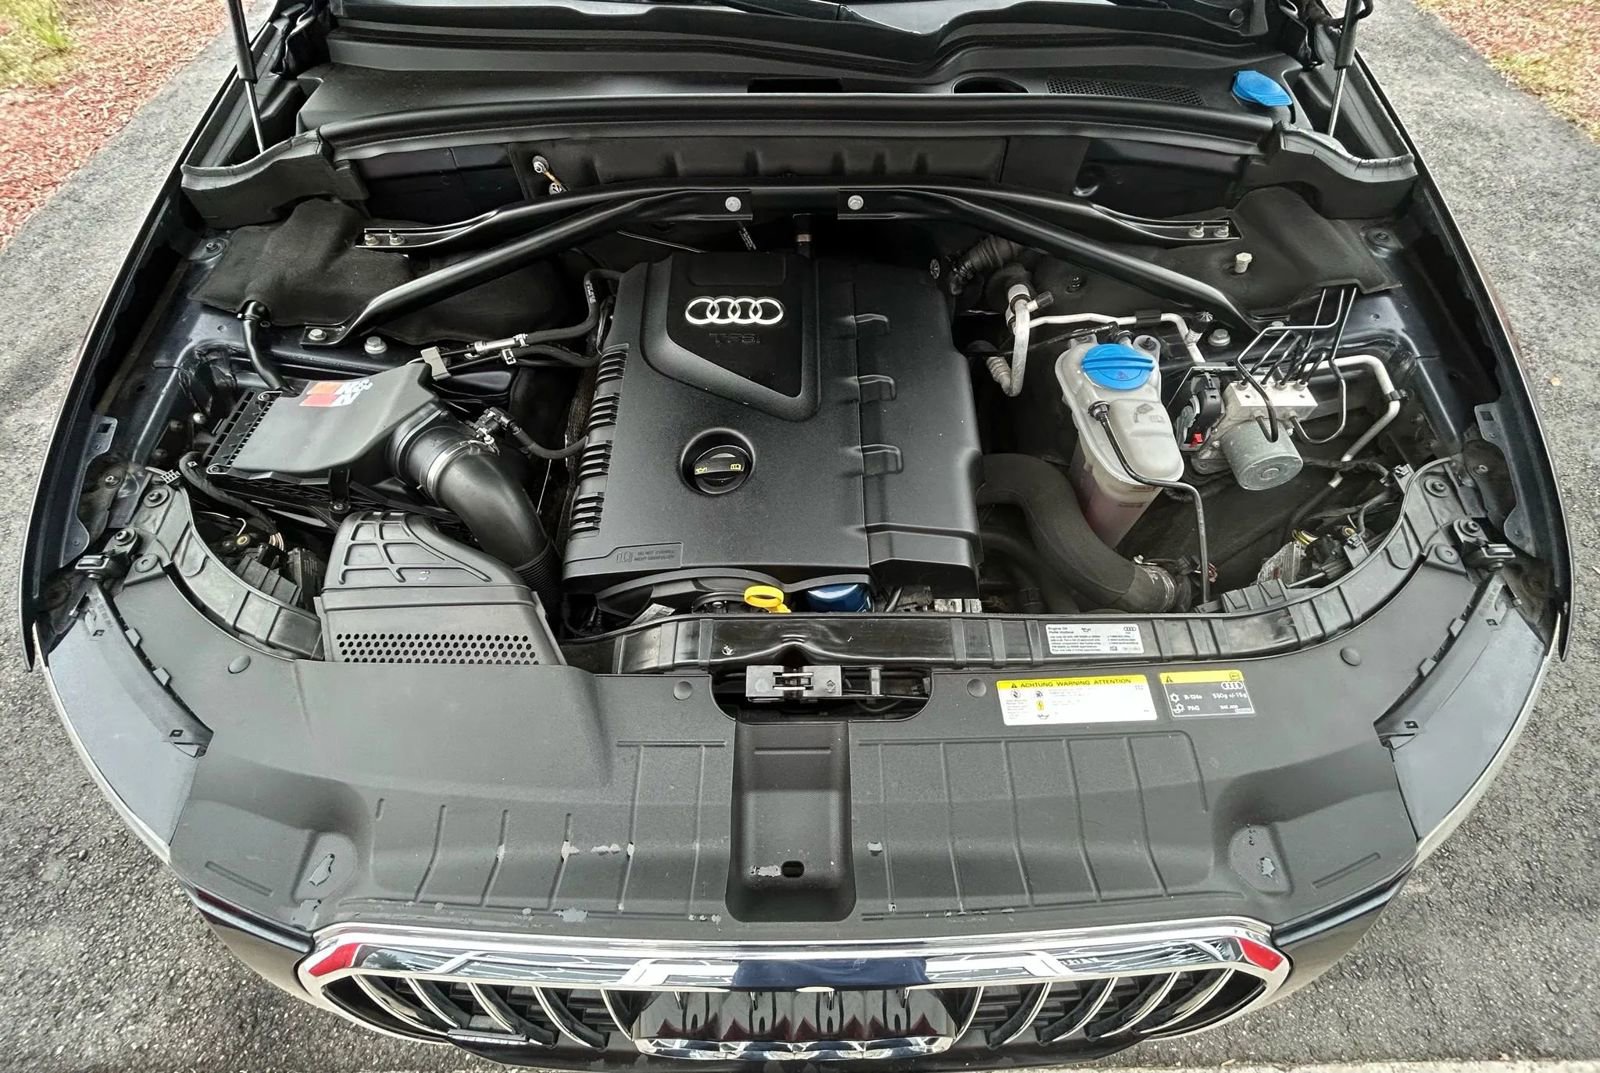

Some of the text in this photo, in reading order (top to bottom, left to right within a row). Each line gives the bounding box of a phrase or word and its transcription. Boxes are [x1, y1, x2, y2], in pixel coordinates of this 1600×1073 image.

[1020, 677, 1132, 689] ACHTUNG WARNING ATTENTION
